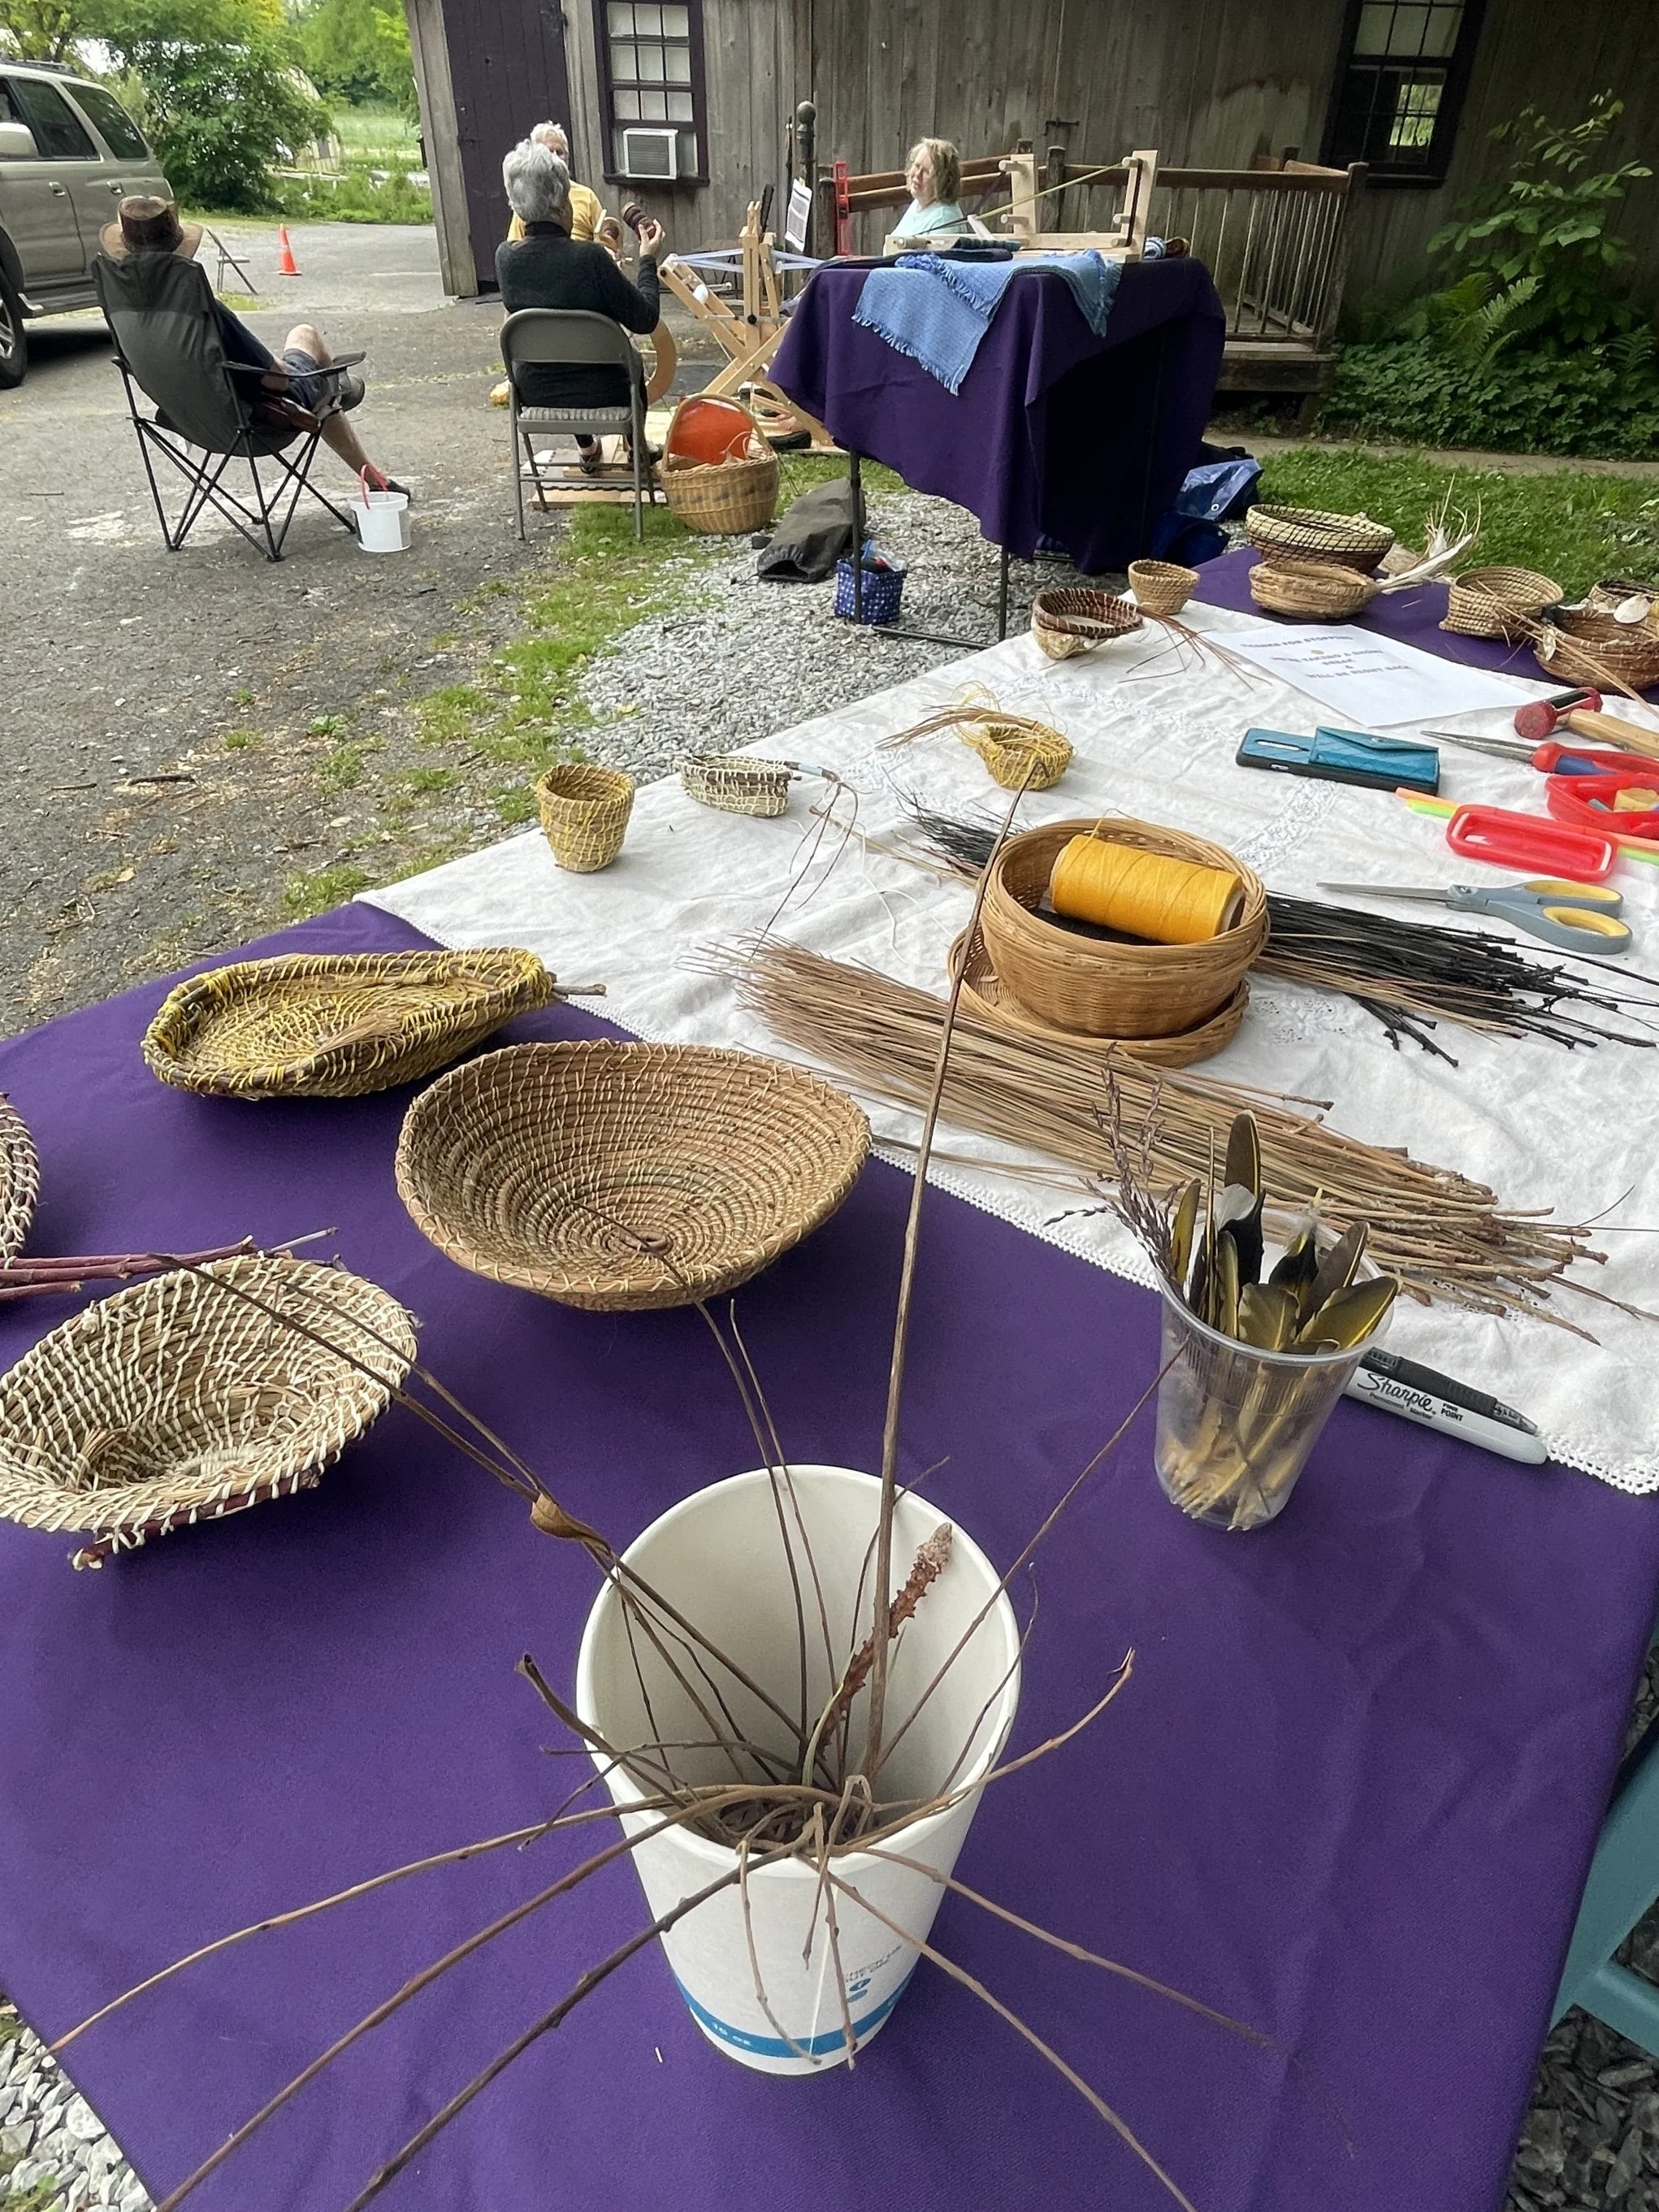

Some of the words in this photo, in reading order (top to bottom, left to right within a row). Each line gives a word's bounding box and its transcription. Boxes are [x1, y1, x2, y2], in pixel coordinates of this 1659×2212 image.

[1302, 653, 1341, 662] TAKING
[1350, 666, 1384, 675] RIGHT
[1384, 664, 1412, 672] BACK
[1357, 1372, 1433, 1412] Sharpie
[1442, 1402, 1458, 1412] FINE
[1410, 1407, 1433, 1420] Marker
[1441, 1408, 1464, 1422] POINT
